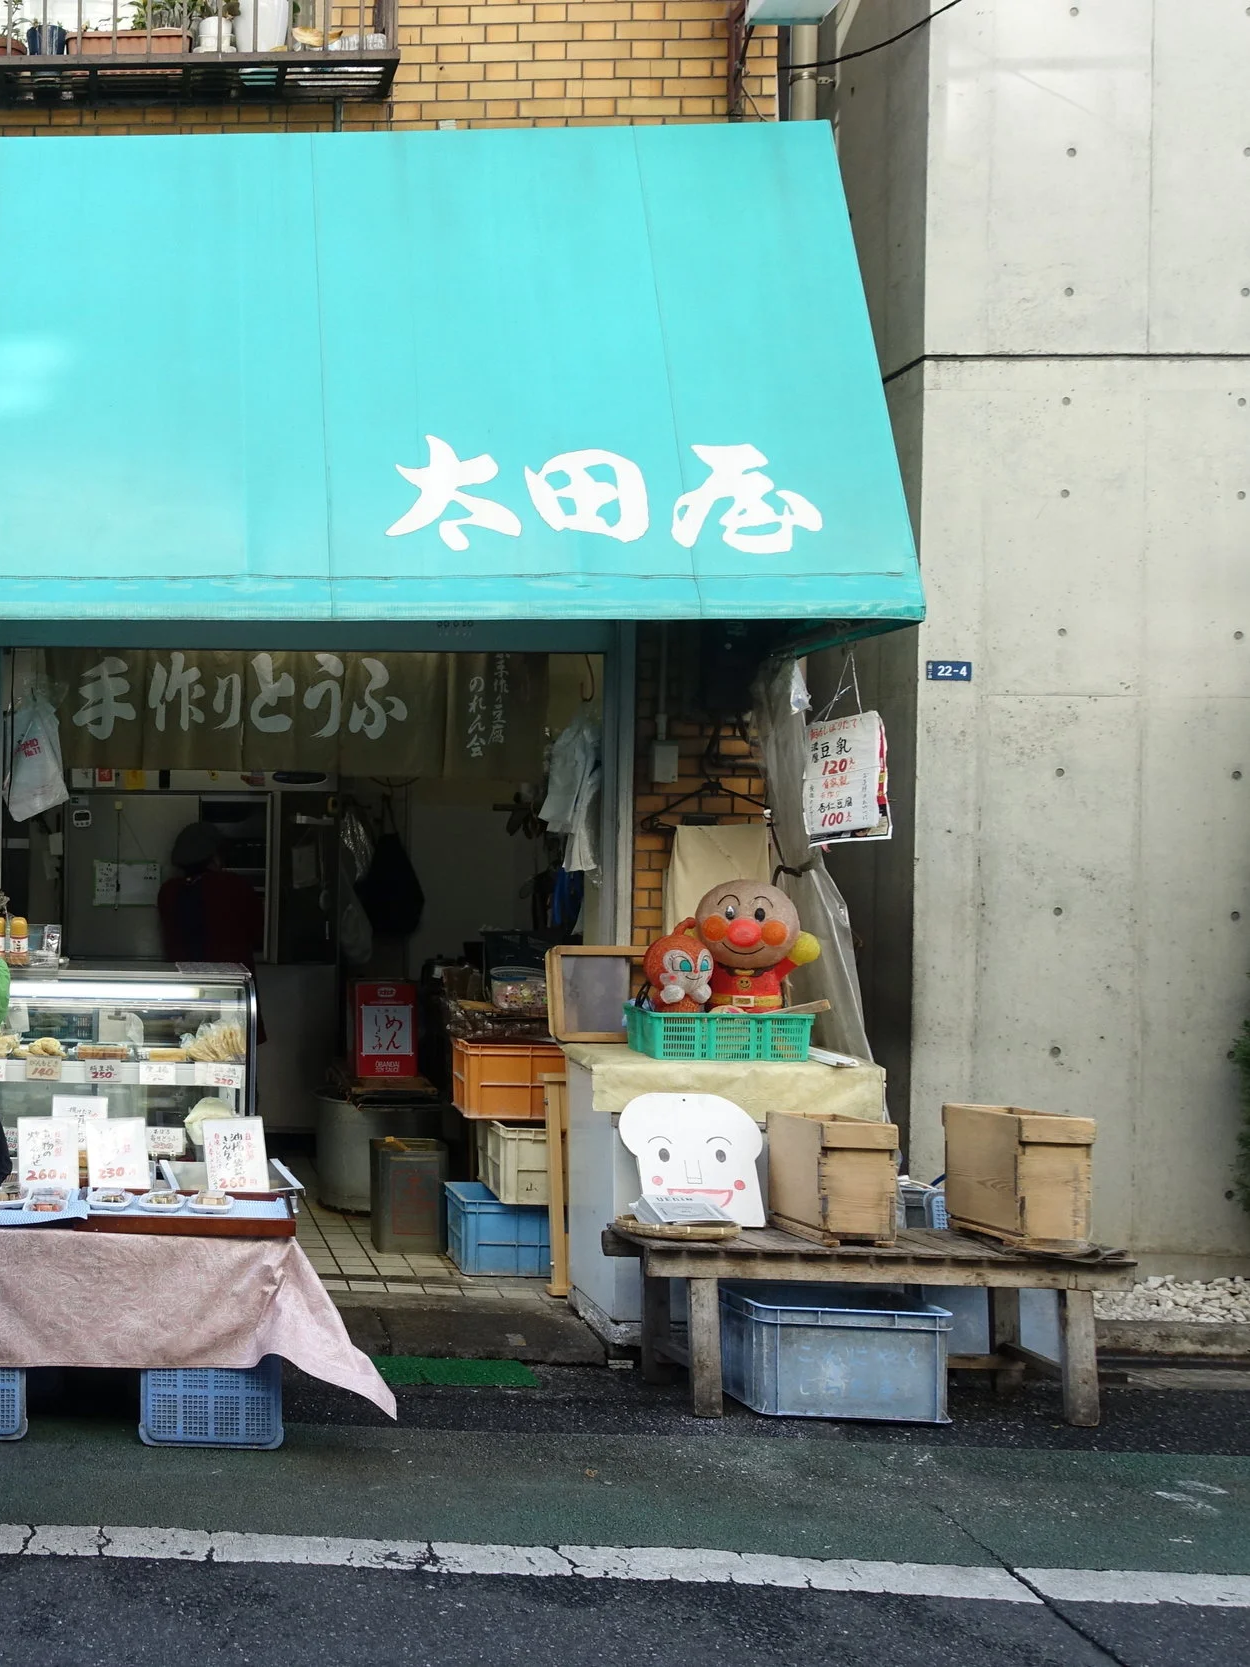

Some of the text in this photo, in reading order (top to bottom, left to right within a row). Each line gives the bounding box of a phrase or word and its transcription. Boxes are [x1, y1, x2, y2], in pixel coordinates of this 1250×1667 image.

[384, 434, 822, 554] 太田屋
[72, 651, 408, 740] 手作りとうふ
[937, 665, 967, 677] 22-4
[466, 676, 487, 757] のれん会
[820, 737, 851, 760] 豆乳
[385, 1014, 403, 1051] めん
